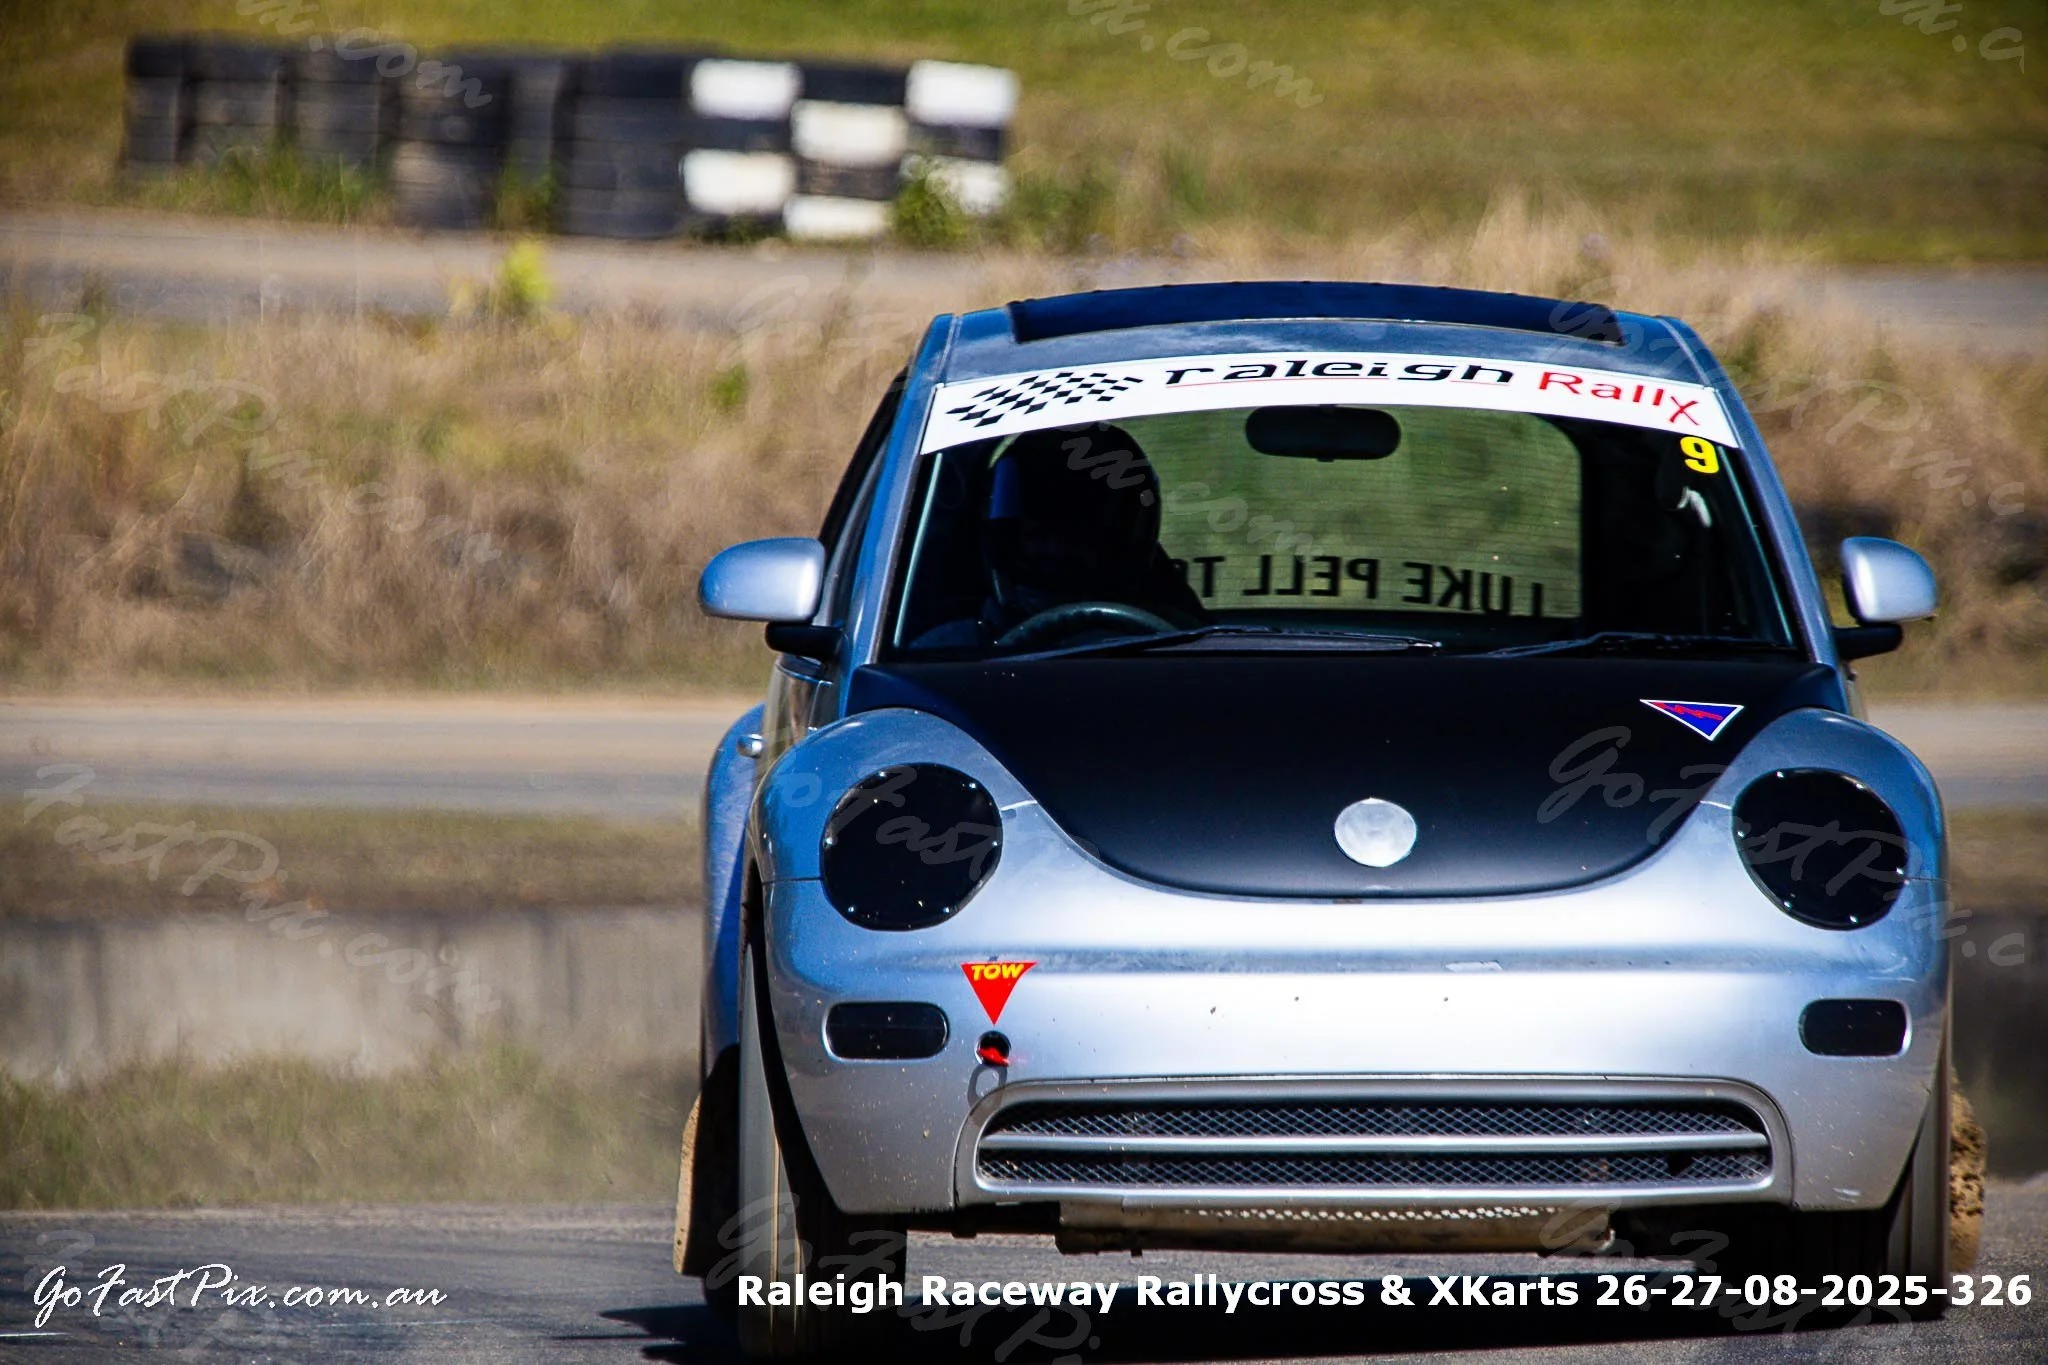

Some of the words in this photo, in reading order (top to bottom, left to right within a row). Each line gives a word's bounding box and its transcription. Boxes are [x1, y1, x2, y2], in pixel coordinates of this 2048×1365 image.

[1164, 359, 1515, 386] raleigh
[1679, 435, 1720, 474] 9
[970, 962, 1025, 982] TOW
